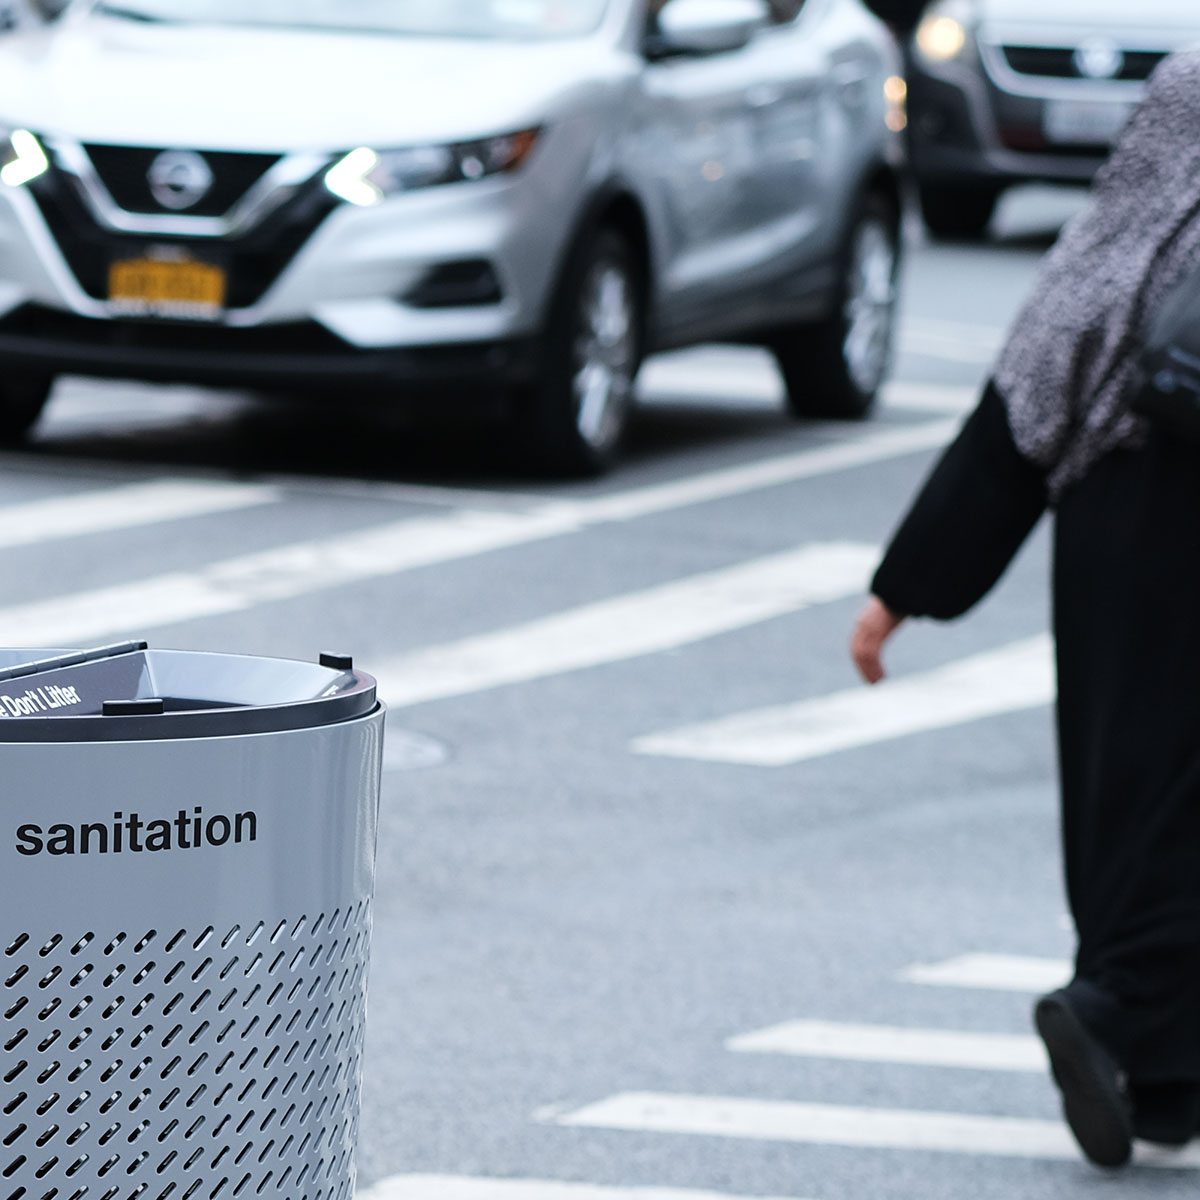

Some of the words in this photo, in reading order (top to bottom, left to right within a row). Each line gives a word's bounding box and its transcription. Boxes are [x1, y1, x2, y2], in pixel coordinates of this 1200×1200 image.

[0, 690, 47, 716] Don't
[37, 685, 81, 708] Litter
[16, 806, 257, 855] sanitation
